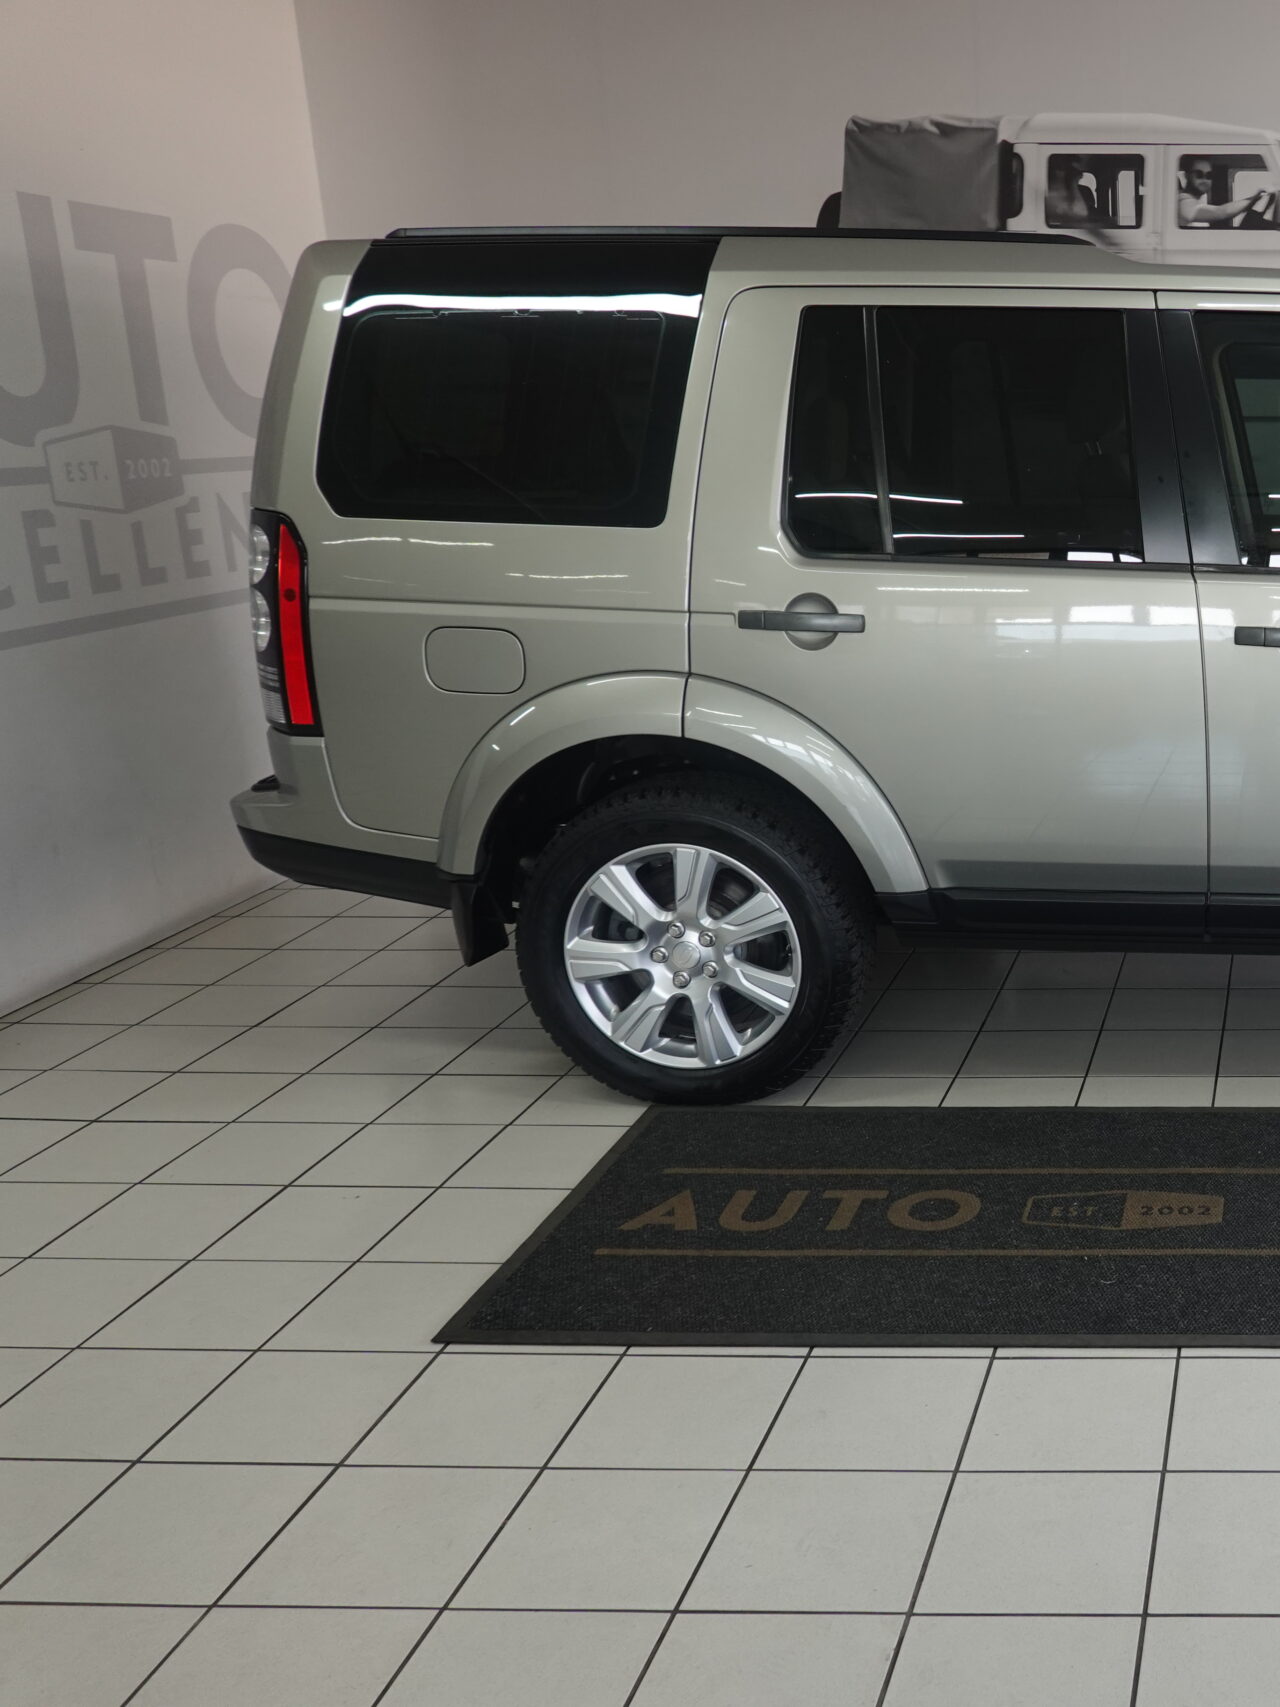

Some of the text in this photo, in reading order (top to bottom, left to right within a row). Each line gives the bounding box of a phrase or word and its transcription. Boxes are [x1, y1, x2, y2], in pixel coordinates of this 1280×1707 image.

[65, 456, 174, 483] EST. 2002
[0, 492, 251, 610] ELLEN
[618, 1188, 983, 1232] AUTO
[1140, 1205, 1212, 1217] 2002
